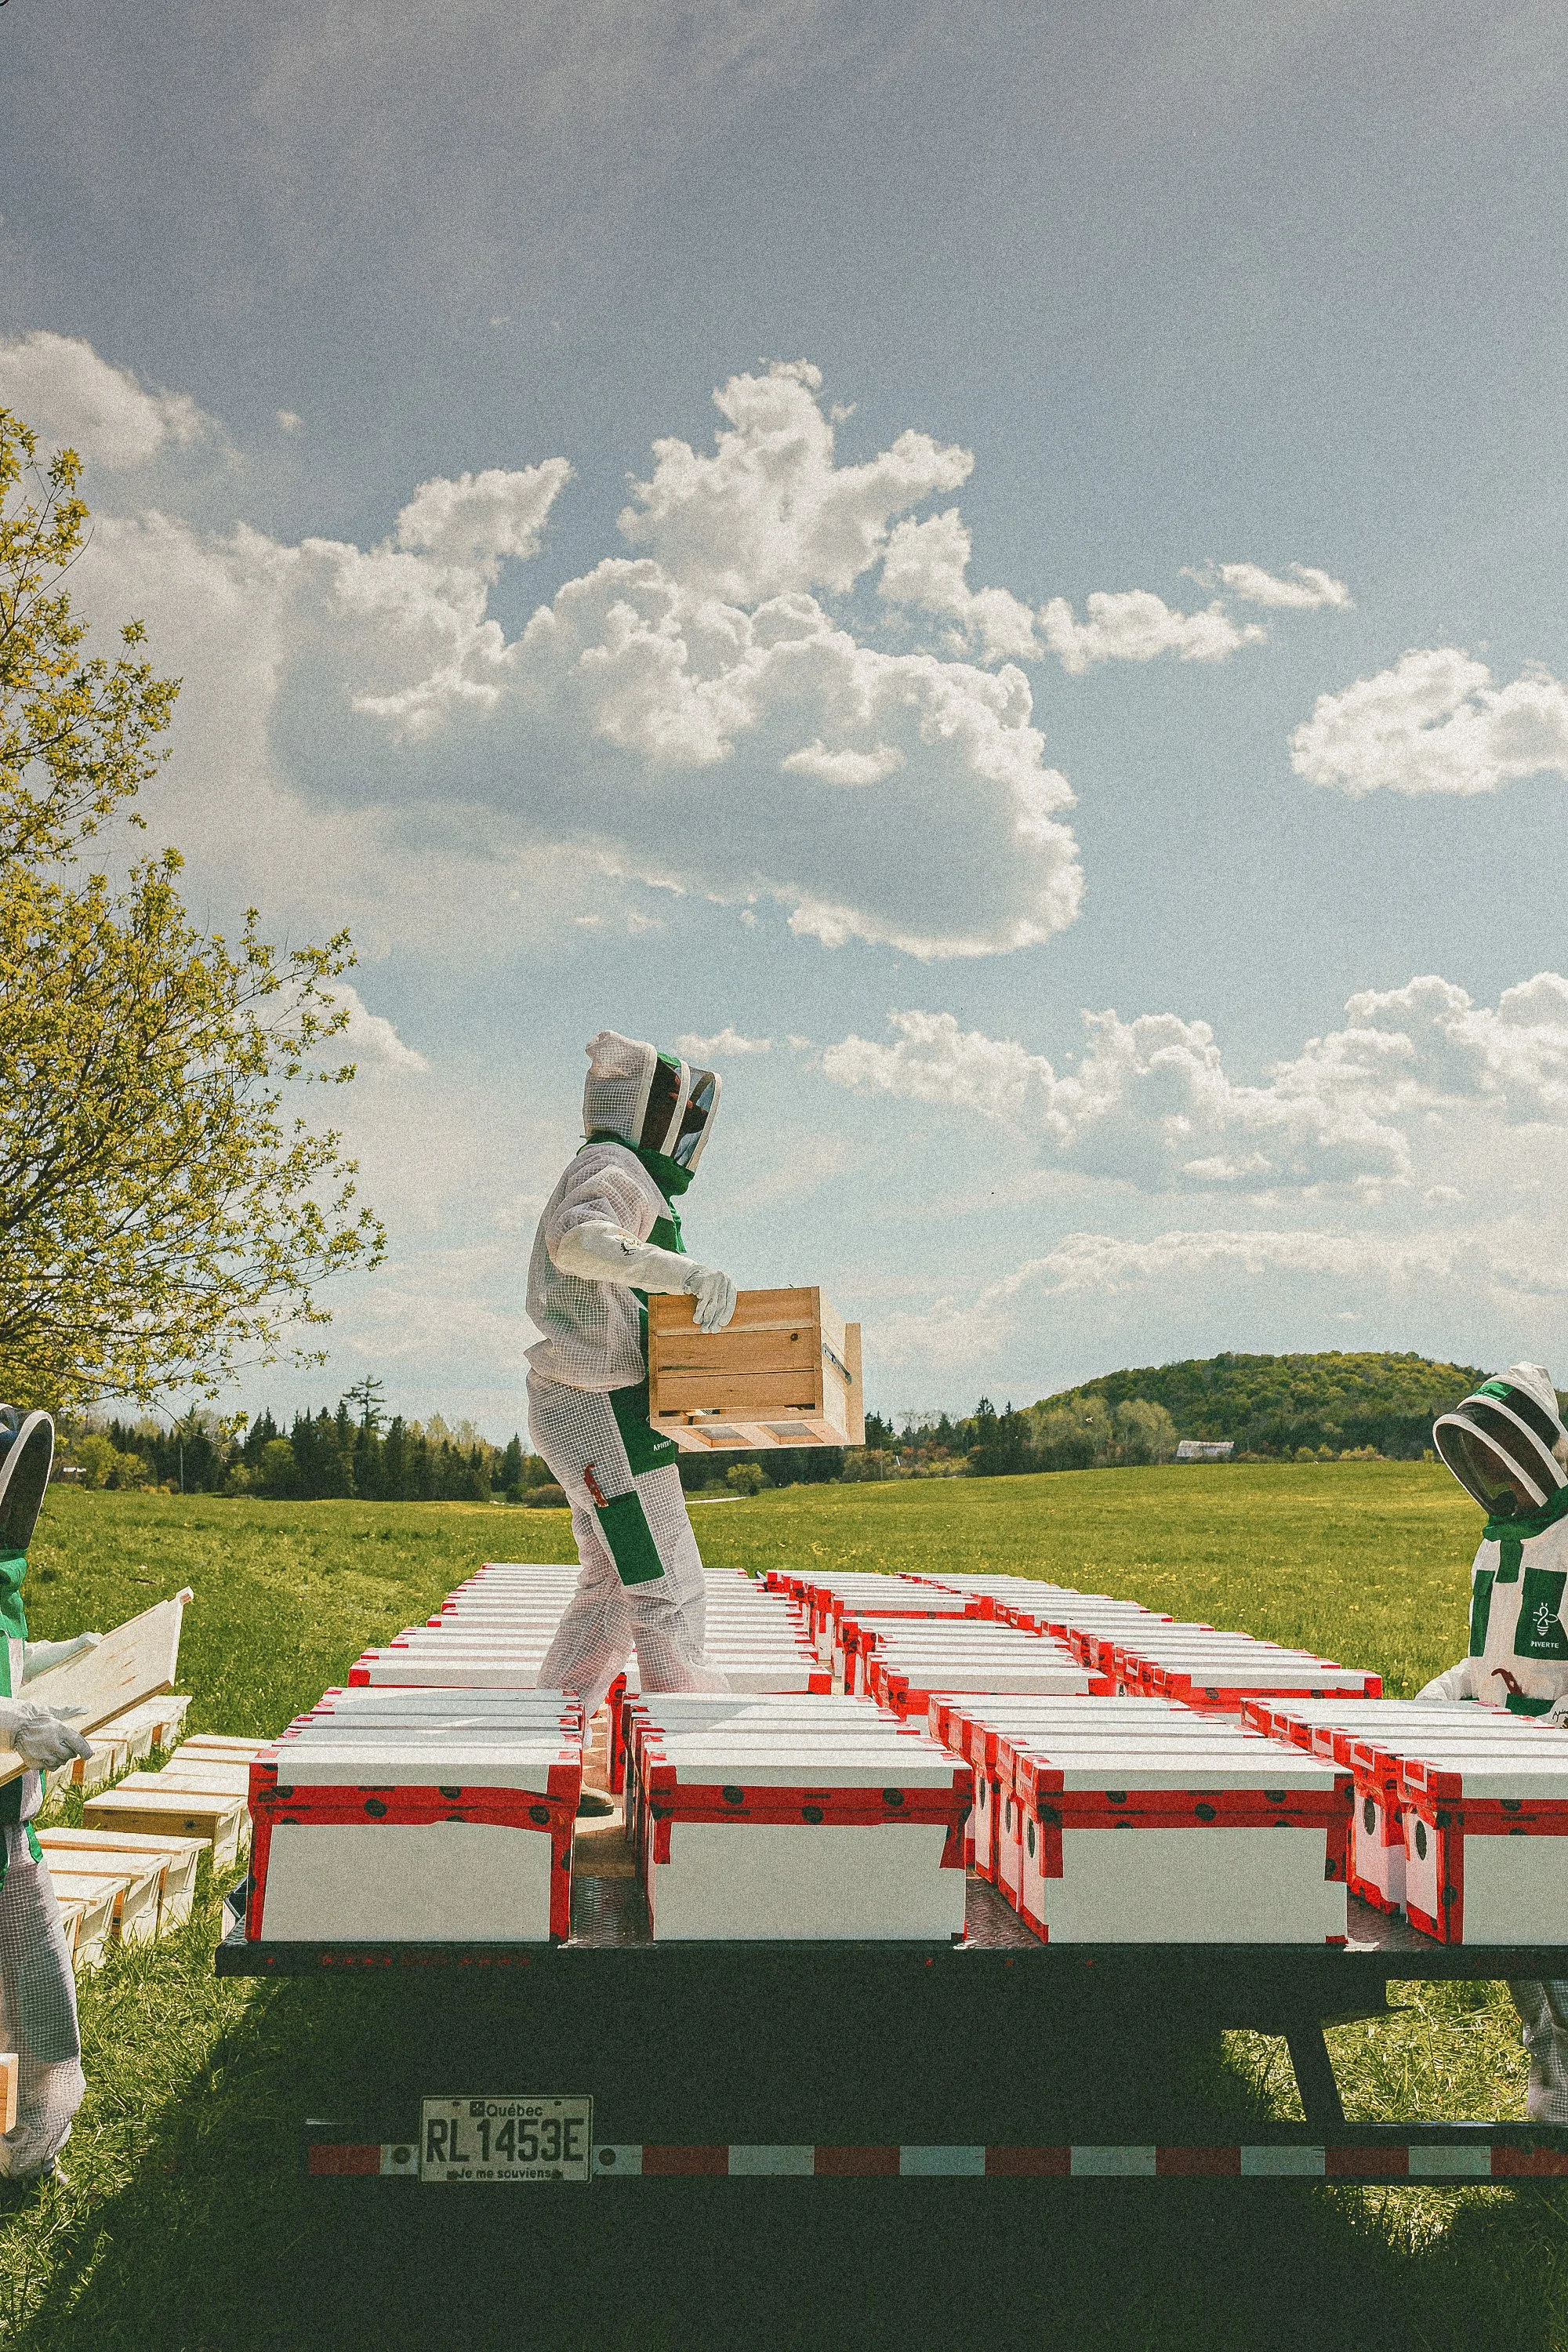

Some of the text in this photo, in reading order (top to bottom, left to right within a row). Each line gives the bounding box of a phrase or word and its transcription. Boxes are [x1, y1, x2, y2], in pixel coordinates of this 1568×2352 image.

[1530, 1640, 1559, 1649] PIVERTE
[486, 2104, 543, 2116] Québec
[458, 2168, 550, 2179] Je me souviens
